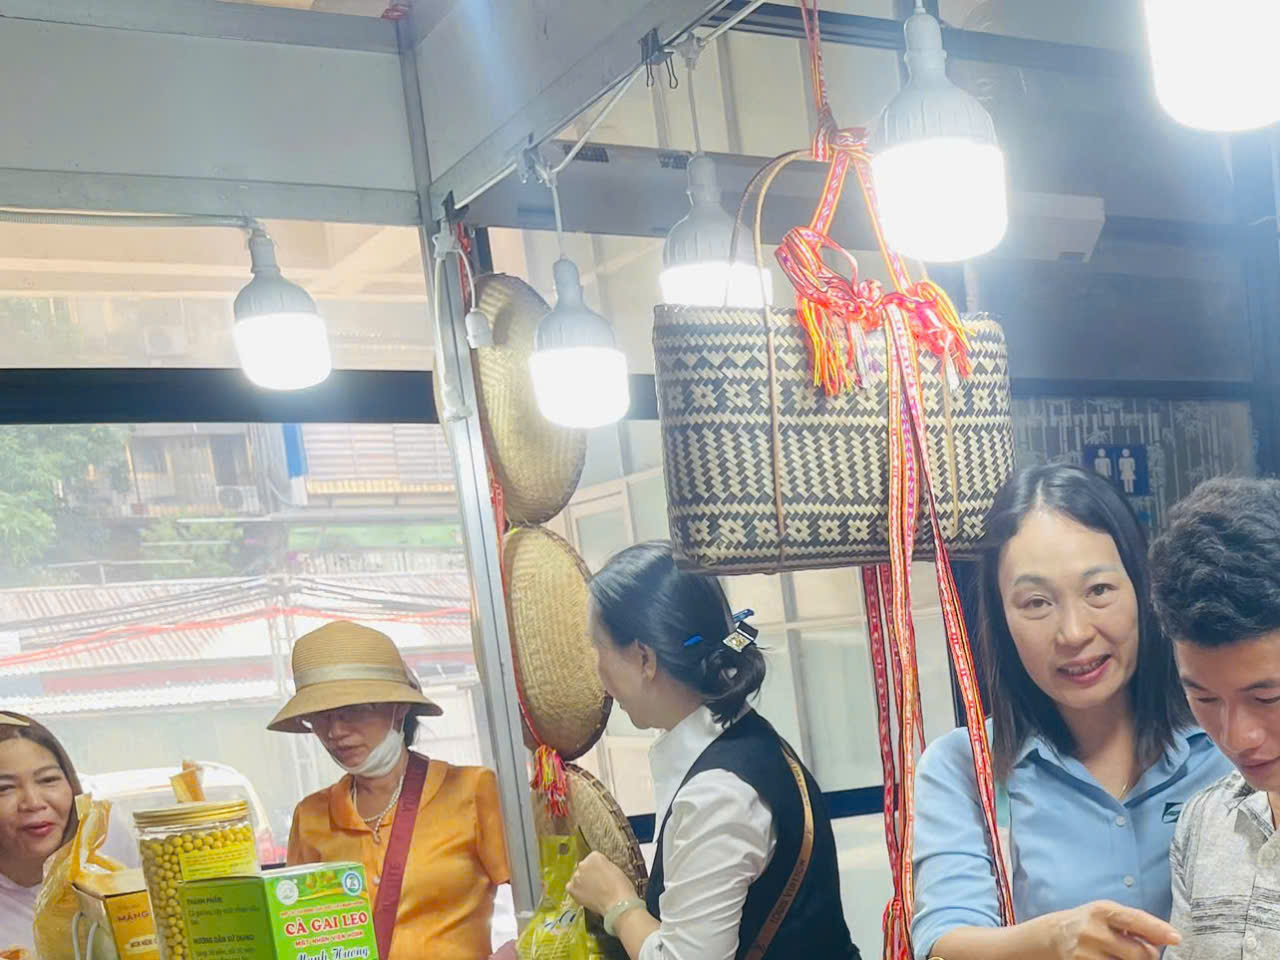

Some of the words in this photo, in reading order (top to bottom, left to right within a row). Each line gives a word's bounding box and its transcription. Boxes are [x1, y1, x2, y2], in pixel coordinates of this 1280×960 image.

[286, 918, 307, 937] CÀ
[311, 916, 338, 933] GAI
[343, 911, 368, 927] LEO
